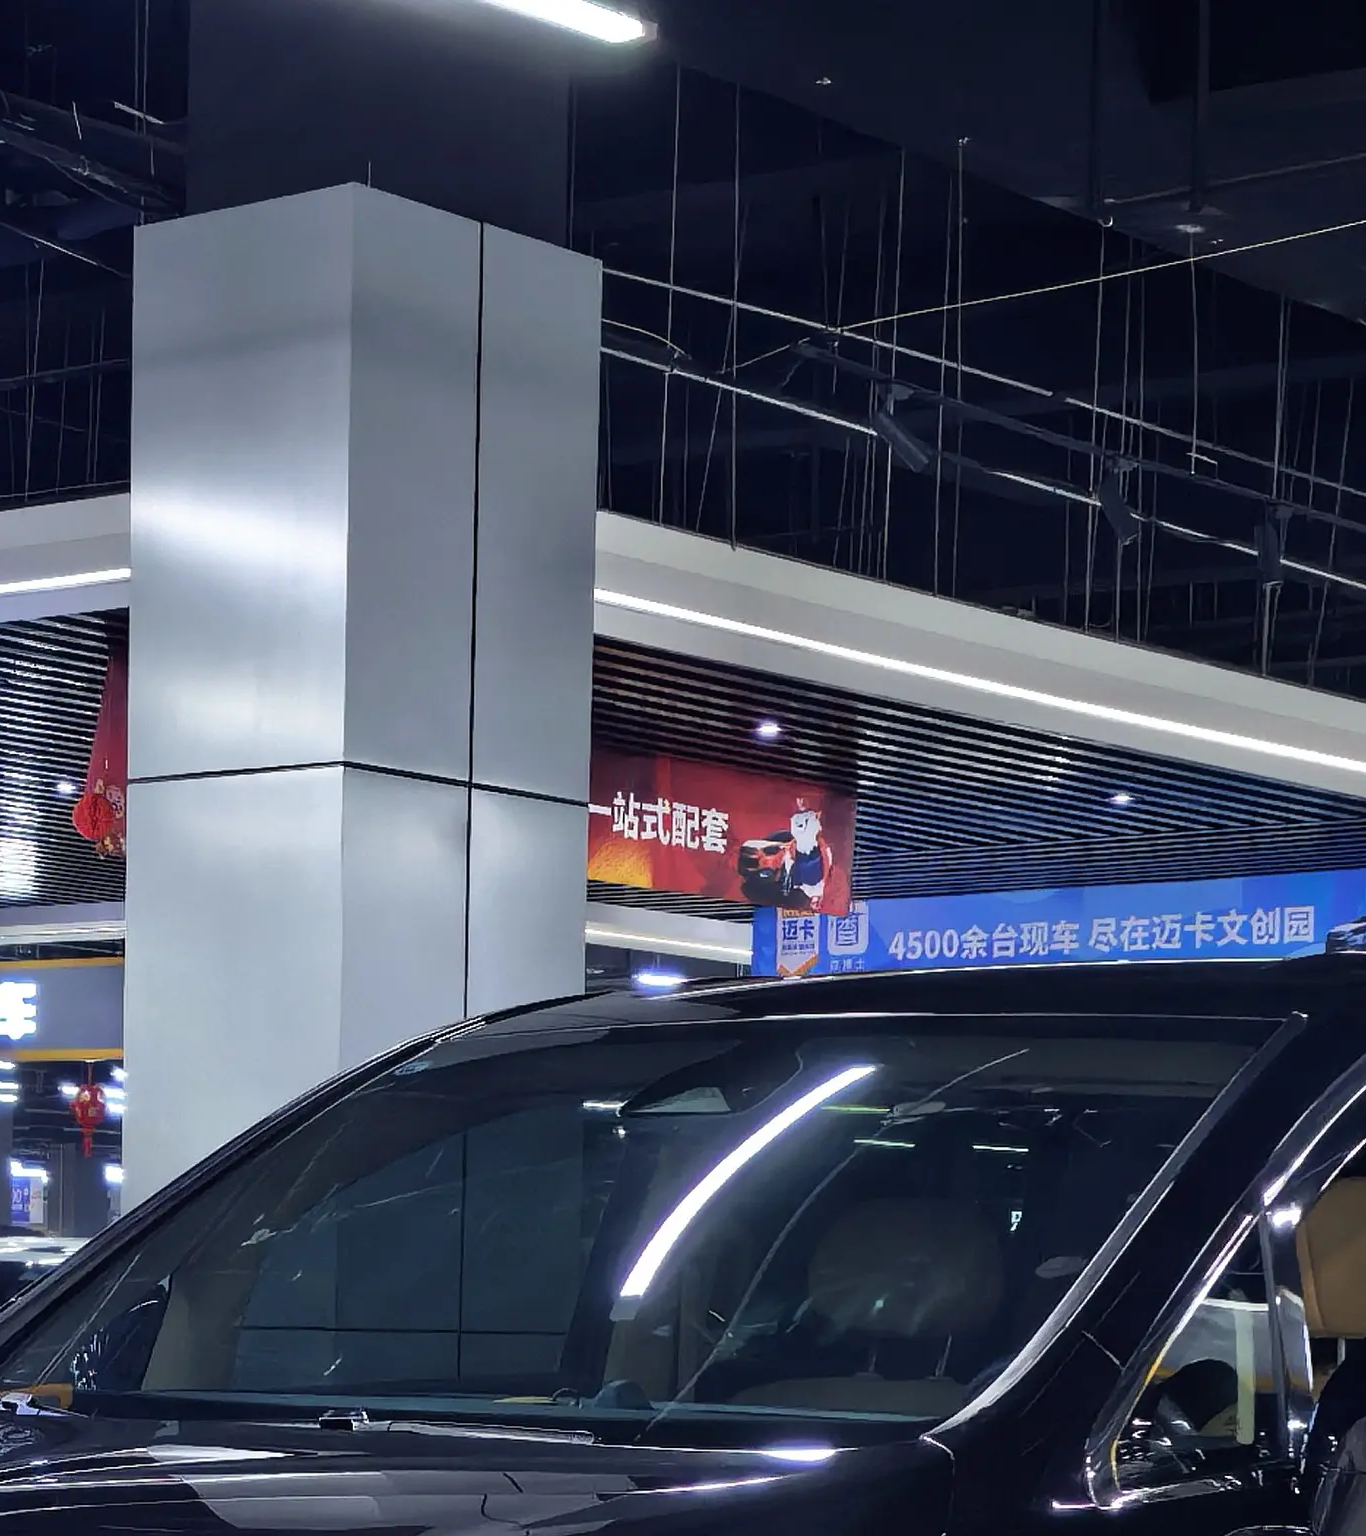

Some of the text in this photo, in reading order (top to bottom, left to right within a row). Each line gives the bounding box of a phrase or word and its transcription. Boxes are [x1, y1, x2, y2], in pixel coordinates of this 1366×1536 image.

[588, 791, 729, 854] 一站式配套
[782, 919, 815, 941] 迈卡
[888, 905, 1316, 961] 4500余台现车 尽在迈卡文创园
